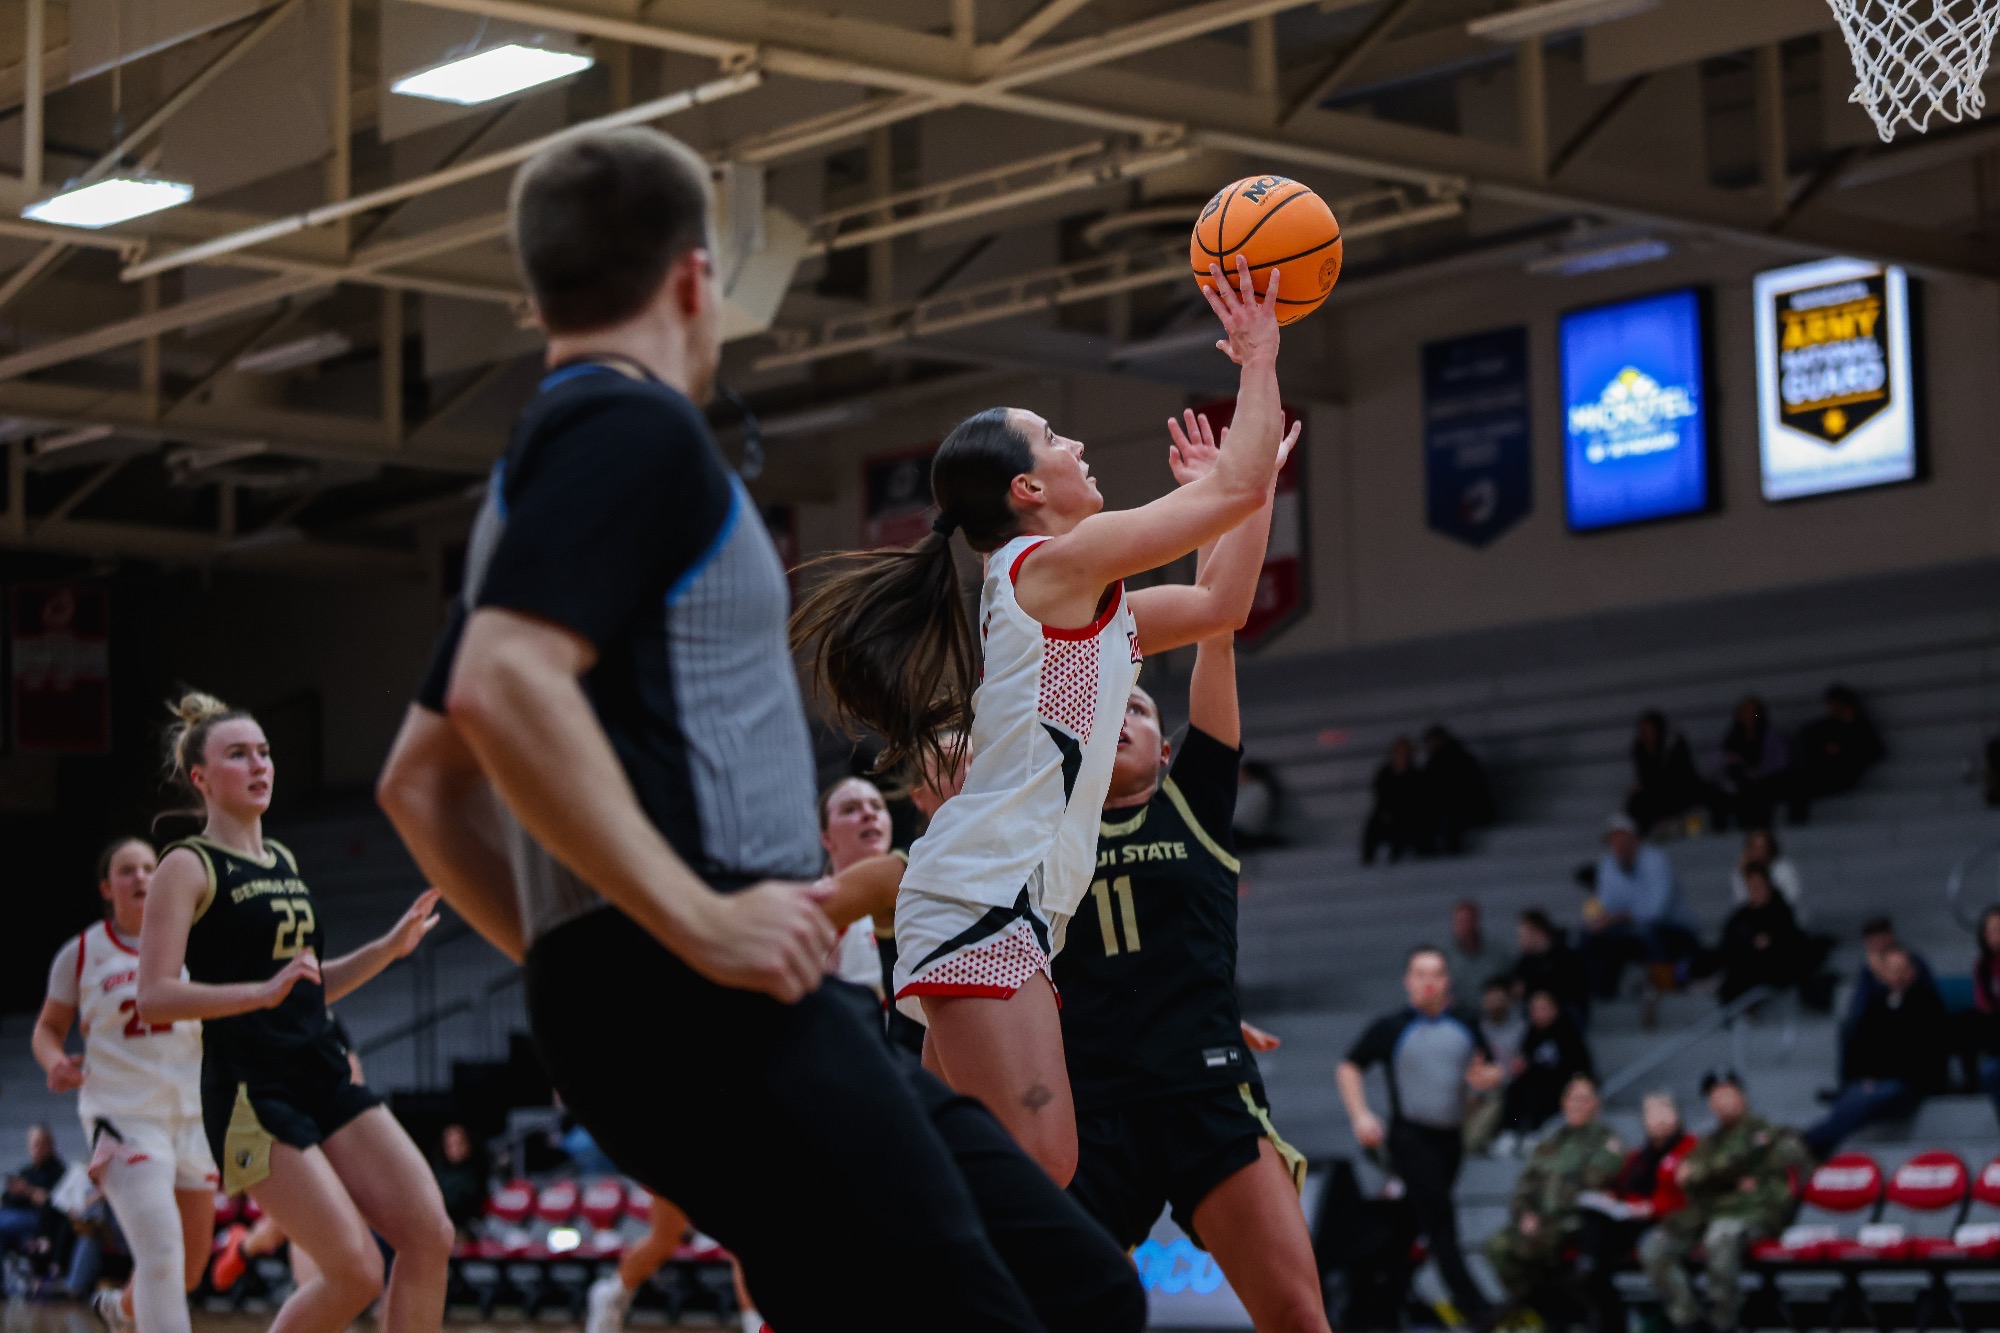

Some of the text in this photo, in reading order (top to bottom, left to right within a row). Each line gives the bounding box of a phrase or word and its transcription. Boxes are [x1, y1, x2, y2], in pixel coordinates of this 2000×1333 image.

[1782, 297, 1880, 351] ARMY
[1782, 364, 1886, 405] GUARD
[1122, 841, 1188, 864] STATE
[270, 898, 315, 960] 22
[1091, 875, 1141, 957] 11
